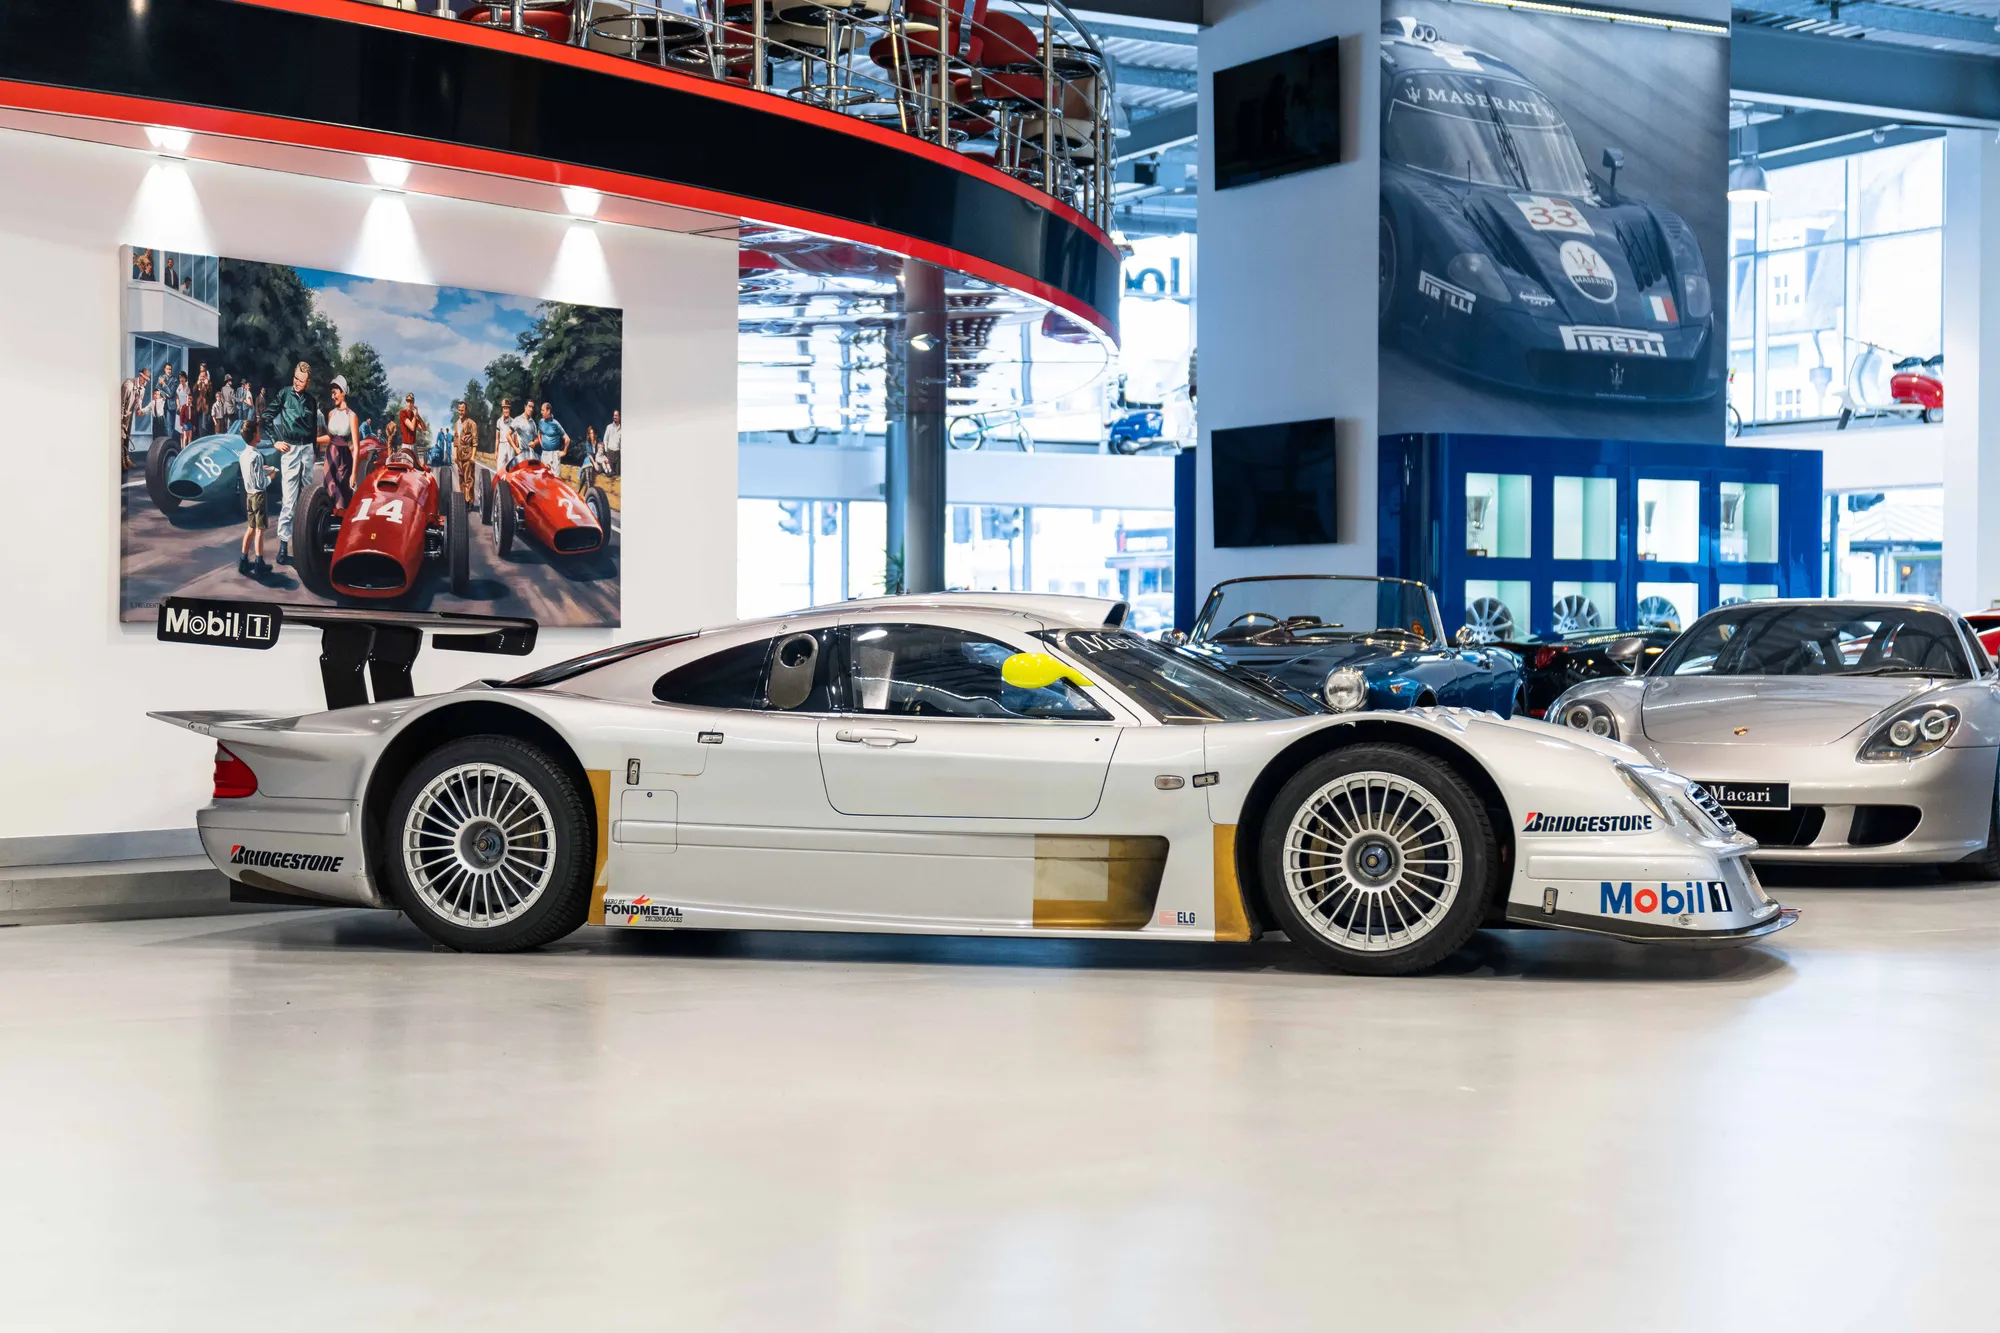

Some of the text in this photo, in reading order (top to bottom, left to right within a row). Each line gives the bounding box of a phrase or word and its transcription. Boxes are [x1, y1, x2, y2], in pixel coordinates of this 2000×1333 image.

[1426, 87, 1542, 117] MASERATI
[1529, 207, 1577, 227] 33
[1559, 325, 1667, 357] PIRELLI
[195, 456, 221, 478] 18
[351, 498, 403, 524] 14
[558, 498, 582, 520] 2
[166, 607, 239, 638] Mobil
[1709, 784, 1771, 802] Macari
[1522, 812, 1652, 832] BRIDGESTONE
[230, 845, 344, 873] BRIDGESTONE
[1600, 882, 1705, 915] Mobil
[604, 904, 683, 916] FONDMETAL
[1177, 911, 1196, 924] ELG
